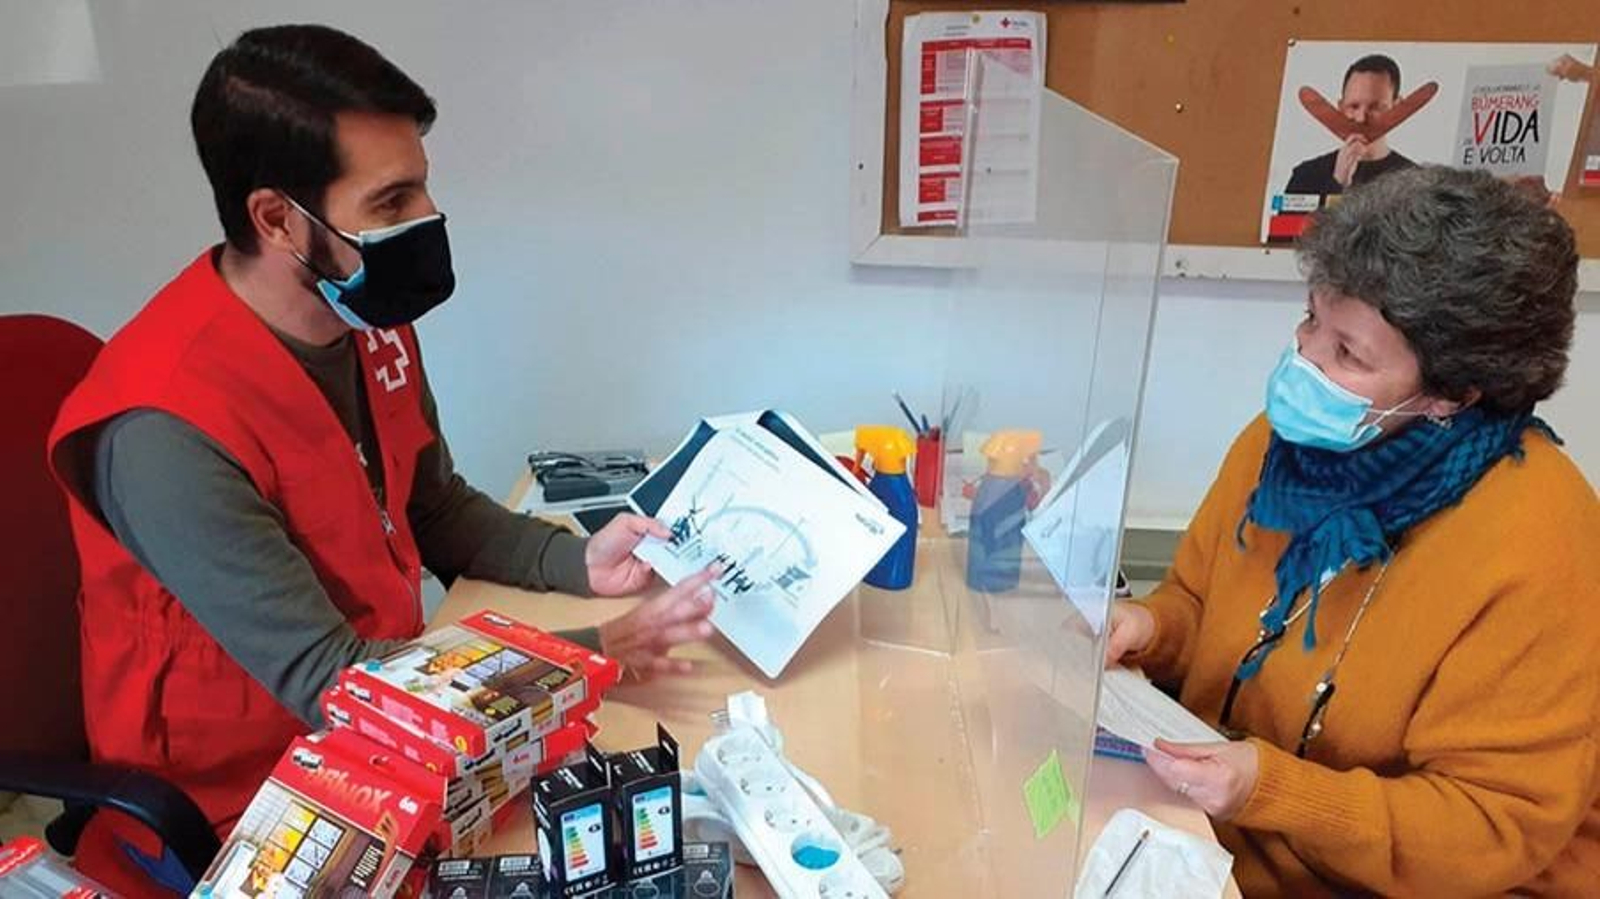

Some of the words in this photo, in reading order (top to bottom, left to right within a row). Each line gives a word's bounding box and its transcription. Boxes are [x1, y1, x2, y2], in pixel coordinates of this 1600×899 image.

[1474, 109, 1539, 145] VIDA
[1463, 147, 1473, 165] E
[1480, 146, 1526, 164] VOLTA
